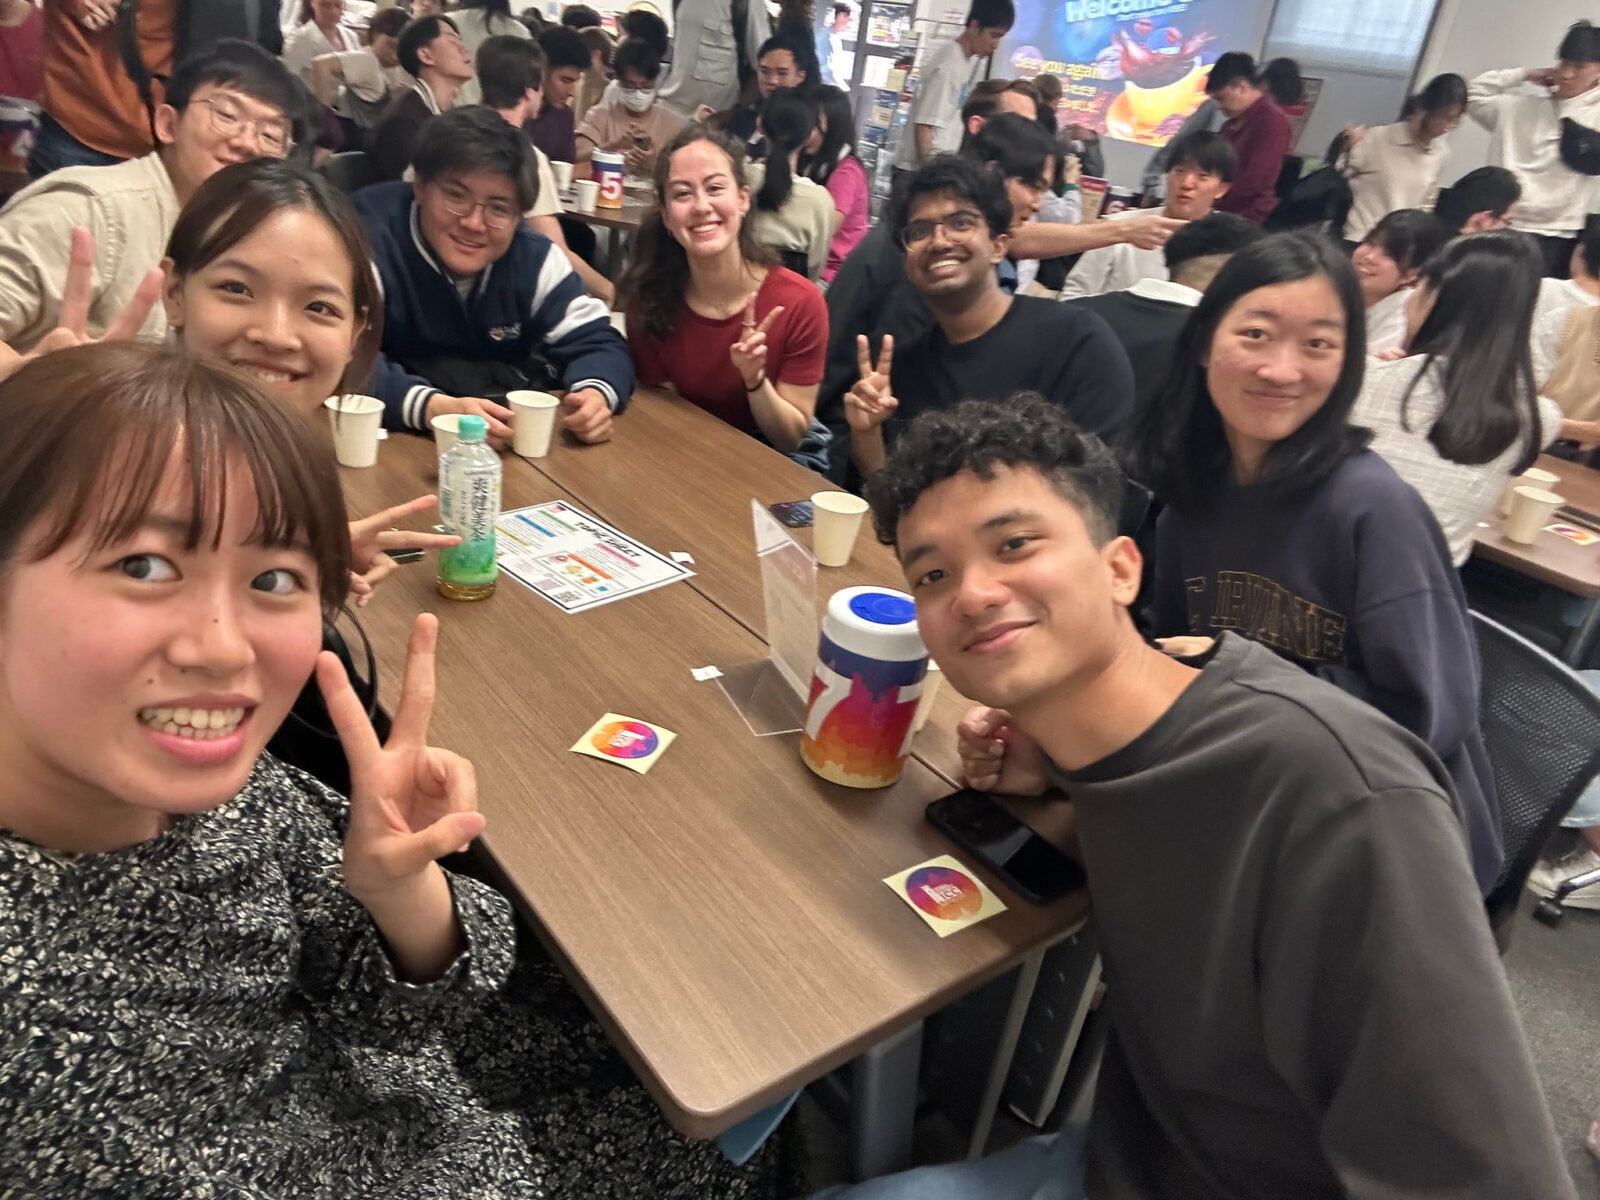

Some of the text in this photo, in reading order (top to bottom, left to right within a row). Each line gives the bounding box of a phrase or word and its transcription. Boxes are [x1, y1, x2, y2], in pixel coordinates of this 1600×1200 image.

[1037, 61, 1066, 75] you
[601, 171, 621, 200] 5
[574, 521, 608, 540] TOPIC
[805, 656, 854, 742] 7
